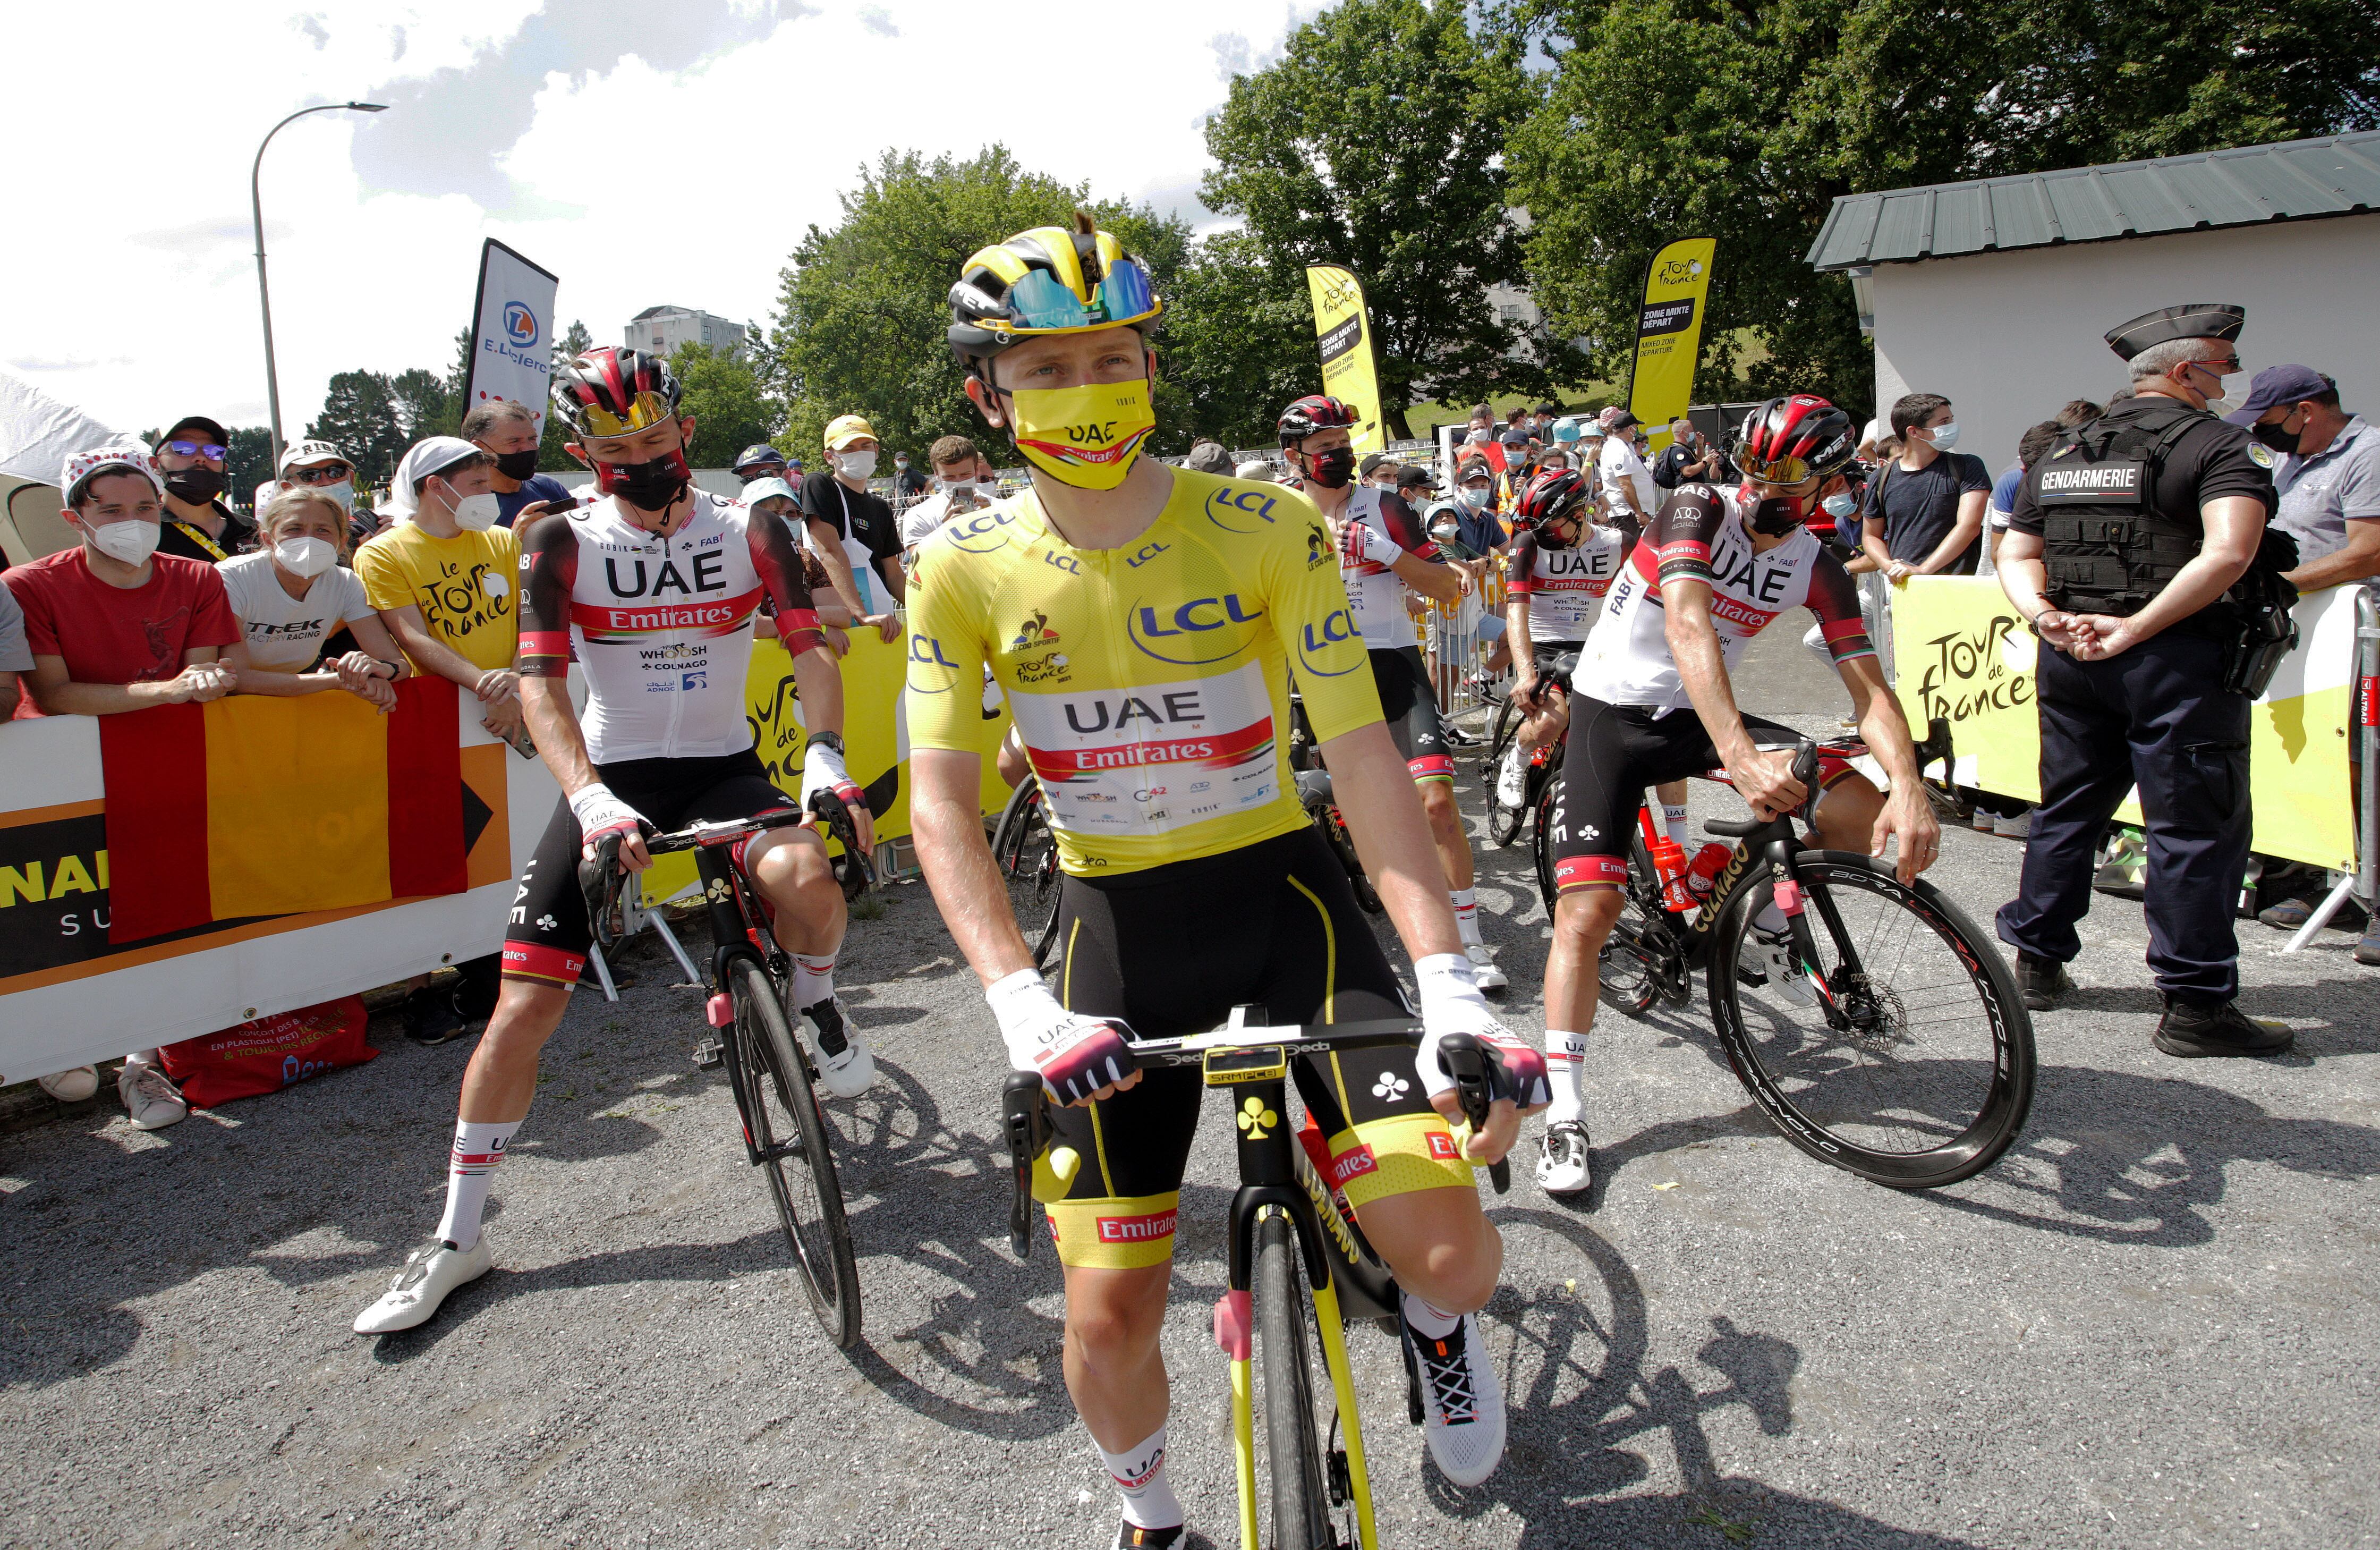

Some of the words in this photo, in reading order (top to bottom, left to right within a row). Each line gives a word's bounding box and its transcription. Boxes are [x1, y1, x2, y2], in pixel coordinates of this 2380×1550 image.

[951, 281, 999, 309] MET
[1644, 309, 1664, 319] ZONE
[1666, 305, 1689, 317] MIXTE
[1321, 333, 1338, 349] ZONE
[1338, 320, 1357, 339] MIXTE
[1641, 339, 1661, 349] MIXED
[1640, 346, 1673, 357] DEPARTURE
[1325, 361, 1341, 374] MIXED
[1342, 352, 1355, 365] ZONE
[1326, 361, 1354, 382] DEPARTURE
[550, 386, 578, 413] MET
[1065, 421, 1118, 443] UAE
[1814, 433, 1847, 463] MET
[2041, 469, 2135, 489] GENDARMERIE
[1674, 485, 1710, 500] FAB
[1216, 487, 1277, 523] LCL
[1547, 493, 1565, 515] MET
[949, 513, 1016, 540] LCL
[600, 543, 628, 553] GOBIK
[1126, 542, 1171, 568] LCL
[605, 549, 727, 598] UAE
[1045, 550, 1081, 575] LCL
[1549, 553, 1609, 574] UAE
[1544, 580, 1606, 590] Emirates
[1610, 583, 1631, 615] FAB
[247, 619, 324, 634] TREK
[608, 606, 733, 628] Emirates
[1140, 594, 1262, 637] LCL
[245, 633, 287, 643] FACTORY
[287, 630, 320, 640] RACING
[1304, 609, 1362, 651] LCL
[1034, 637, 1060, 647] SPORTIF
[654, 660, 707, 670] COLNAGO
[1988, 659, 2004, 681] de
[1064, 691, 1205, 734] UAE
[777, 724, 798, 749] de
[1079, 724, 1201, 742] TEAM
[1075, 742, 1213, 769] Emirates
[591, 810, 616, 824] UAE
[1691, 877, 1710, 890] UAE
[1695, 842, 1749, 932] COLNAGO
[1774, 874, 1790, 883] UAE
[1829, 870, 1902, 900] BORA
[1907, 900, 1978, 972] ULTRA
[1978, 978, 2006, 1043] WTO
[277, 1021, 292, 1032] DES
[227, 1038, 275, 1048] PLASTIQUE
[276, 1031, 300, 1044] (PET)
[1285, 1042, 1330, 1056] Deda
[224, 1051, 234, 1061] &
[237, 1041, 298, 1056] TOUJOURS
[1244, 1070, 1276, 1079] PC8
[1721, 1000, 1839, 1153] CAMPAGNOLO
[1303, 1154, 1359, 1264] COLNAGO
